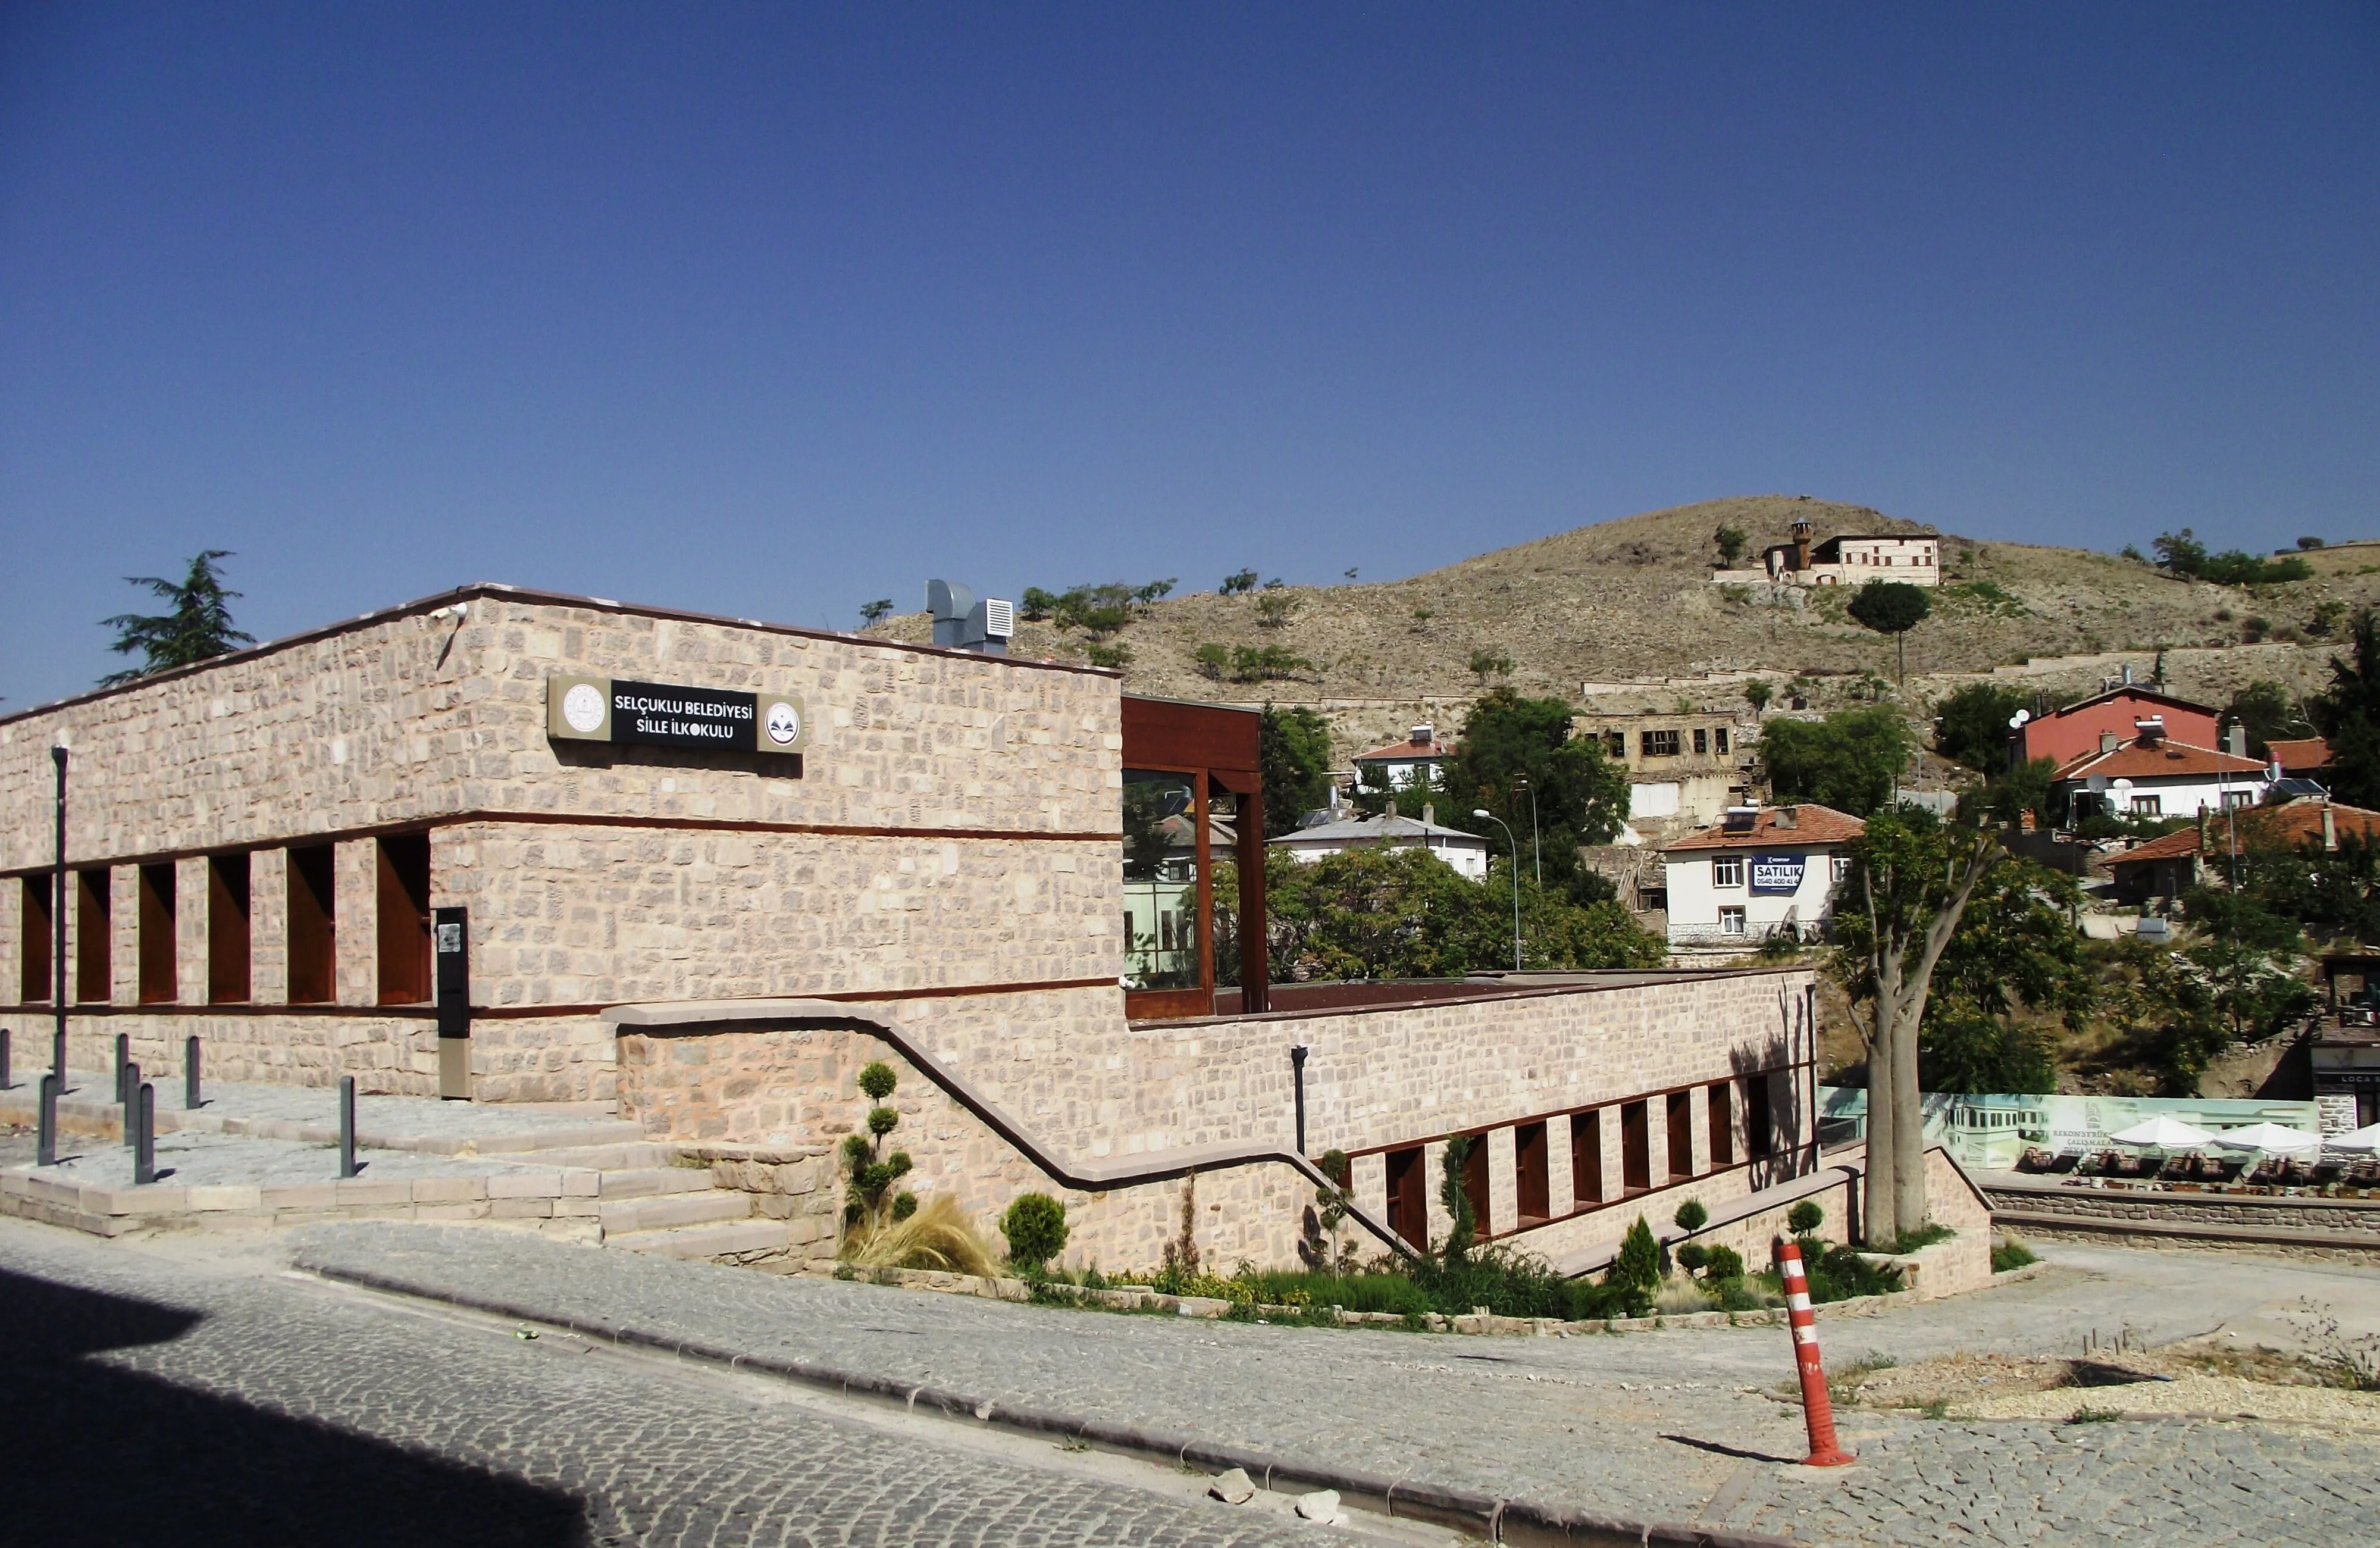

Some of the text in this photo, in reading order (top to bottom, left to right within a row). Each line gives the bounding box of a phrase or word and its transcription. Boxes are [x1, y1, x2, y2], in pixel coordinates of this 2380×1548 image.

[615, 695, 753, 720] SELÇUKLU BELEDİYESİ
[636, 716, 734, 739] SİLLE İLKOKULU
[1757, 867, 1801, 877] SATILIK
